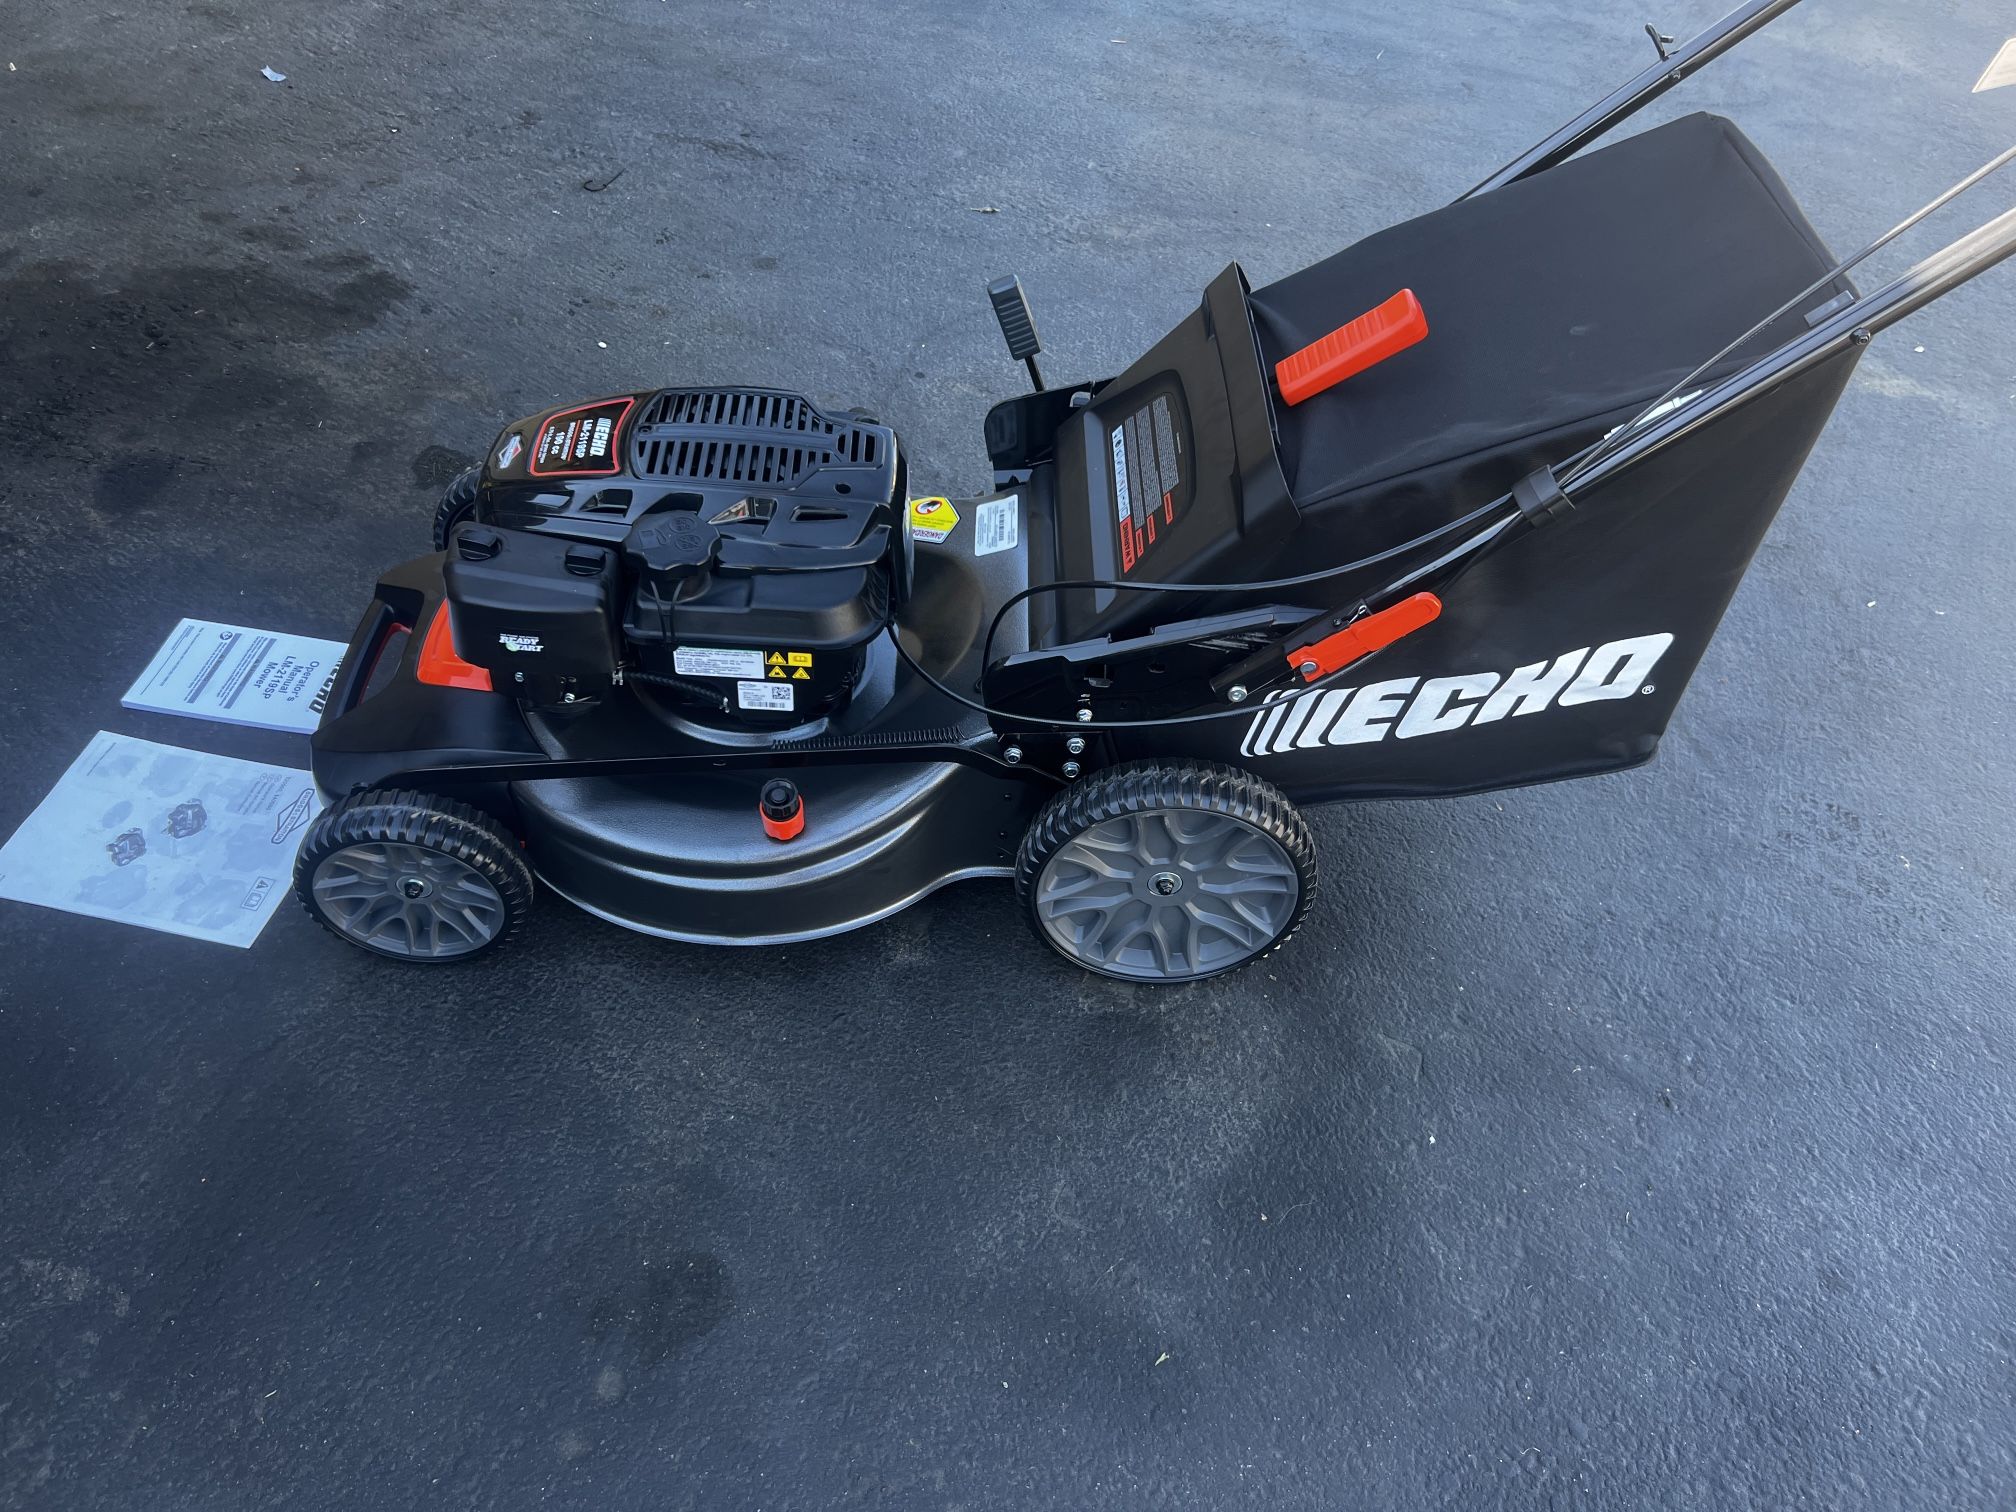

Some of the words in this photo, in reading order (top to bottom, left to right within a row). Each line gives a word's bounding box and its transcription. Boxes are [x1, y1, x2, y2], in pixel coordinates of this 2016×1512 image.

[590, 422, 611, 457] ECHO
[499, 636, 539, 646] READY
[254, 661, 279, 689] Mower
[262, 655, 296, 699] LM-2119SP
[278, 664, 304, 694] Manual
[286, 660, 320, 702] Operator's
[1326, 632, 1675, 746] ECHO
